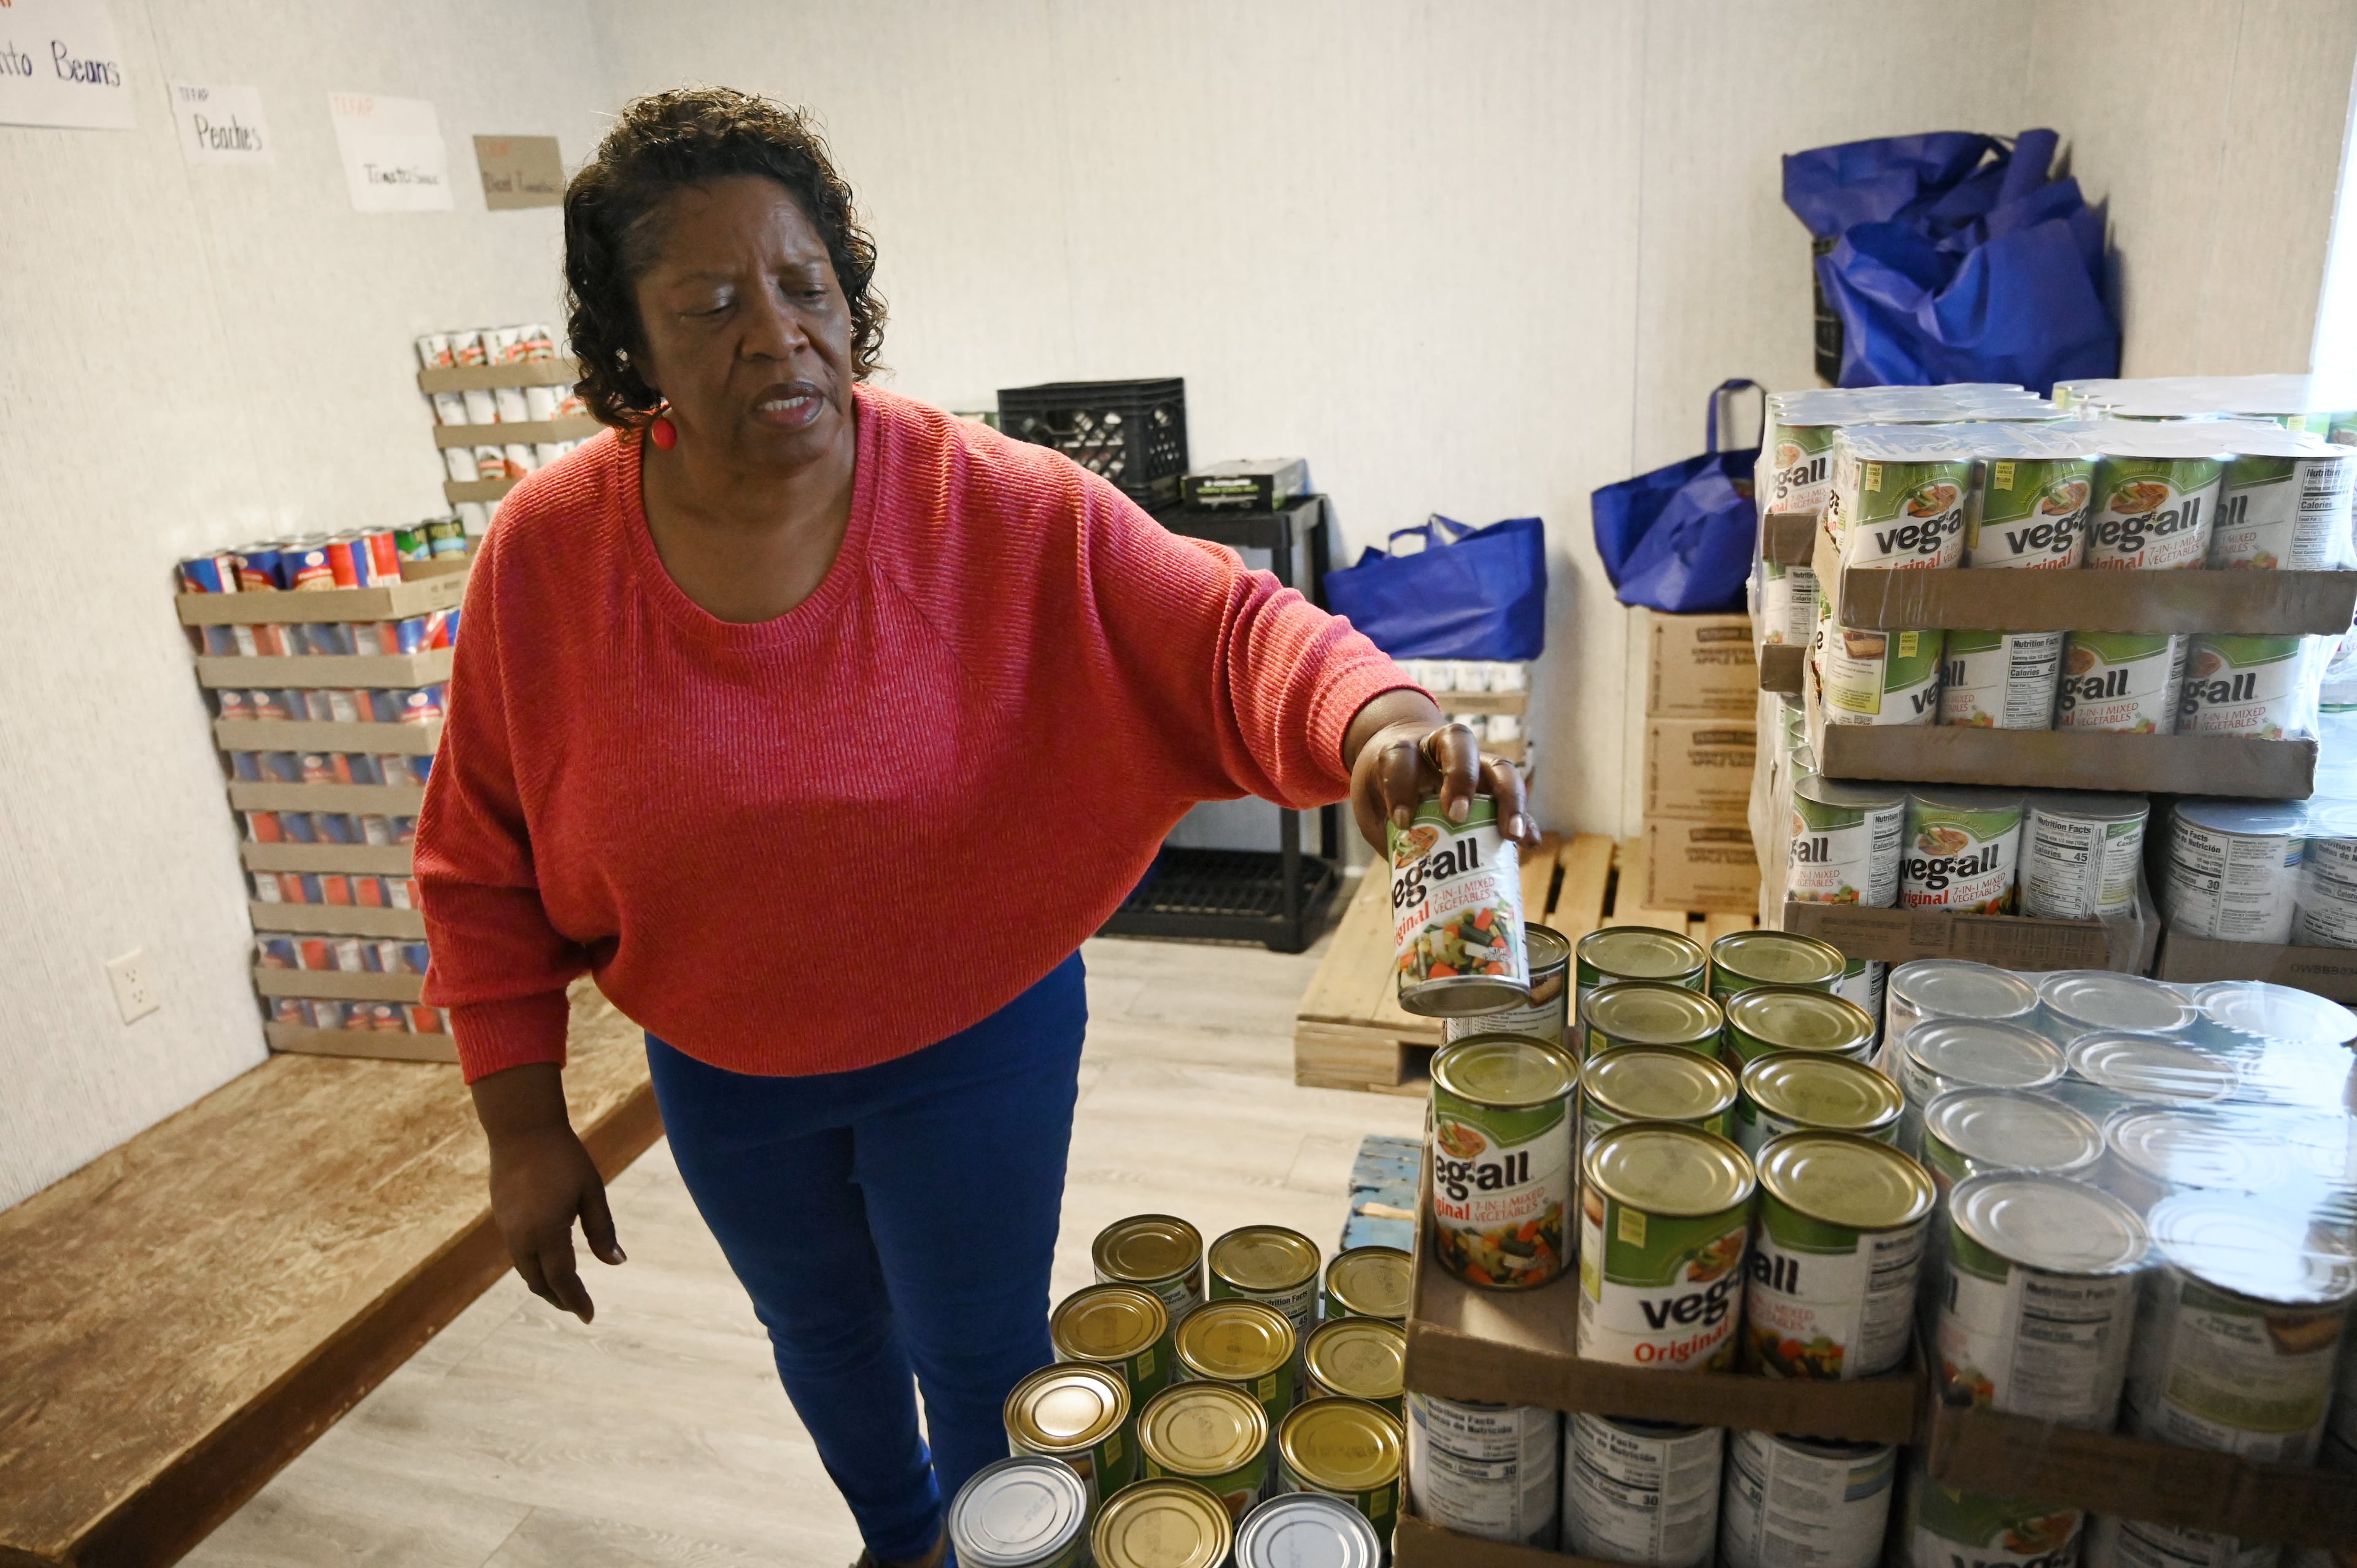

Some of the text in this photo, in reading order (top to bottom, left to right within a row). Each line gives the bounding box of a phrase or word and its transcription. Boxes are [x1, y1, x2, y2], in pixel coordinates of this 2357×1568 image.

[51, 40, 120, 87] Beans
[194, 112, 263, 151] Peaches
[2306, 468, 2340, 477] Nutrition
[2301, 501, 2332, 509] Calories
[2150, 531, 2205, 556] 7-IN-1 MIXED
[2148, 543, 2200, 565] VEGETABLES
[2013, 639, 2045, 649] Nutrition
[2106, 702, 2139, 714] MIXED
[2231, 706, 2266, 719] MIXED
[2200, 717, 2258, 731] VEGETABLES
[1875, 813, 1898, 823] Nutrition
[2037, 816, 2091, 834] Nutrition Facts
[2189, 830, 2208, 843] Facts
[1873, 840, 1895, 850] Calories
[2188, 838, 2221, 854] Nutrición
[2034, 845, 2088, 862] Calories 45
[2339, 852, 2350, 860] de
[1813, 869, 1840, 879] MIXED
[1954, 871, 2006, 895] 7-IN-1 MIXED
[2207, 879, 2220, 890] 30
[1433, 876, 1495, 905] 7-IN-1 MIXED
[1953, 882, 2002, 903] VEGETABLES
[1433, 888, 1492, 915] VEGETABLES
[1475, 1186, 1545, 1213] 7-IN-1 MIXED
[1474, 1202, 1538, 1222] VEGETABLES
[1291, 1290, 1308, 1302] Facts
[1298, 1315, 1308, 1326] 45
[1633, 1313, 1730, 1363] Original
[1468, 1415, 1495, 1426] Facts
